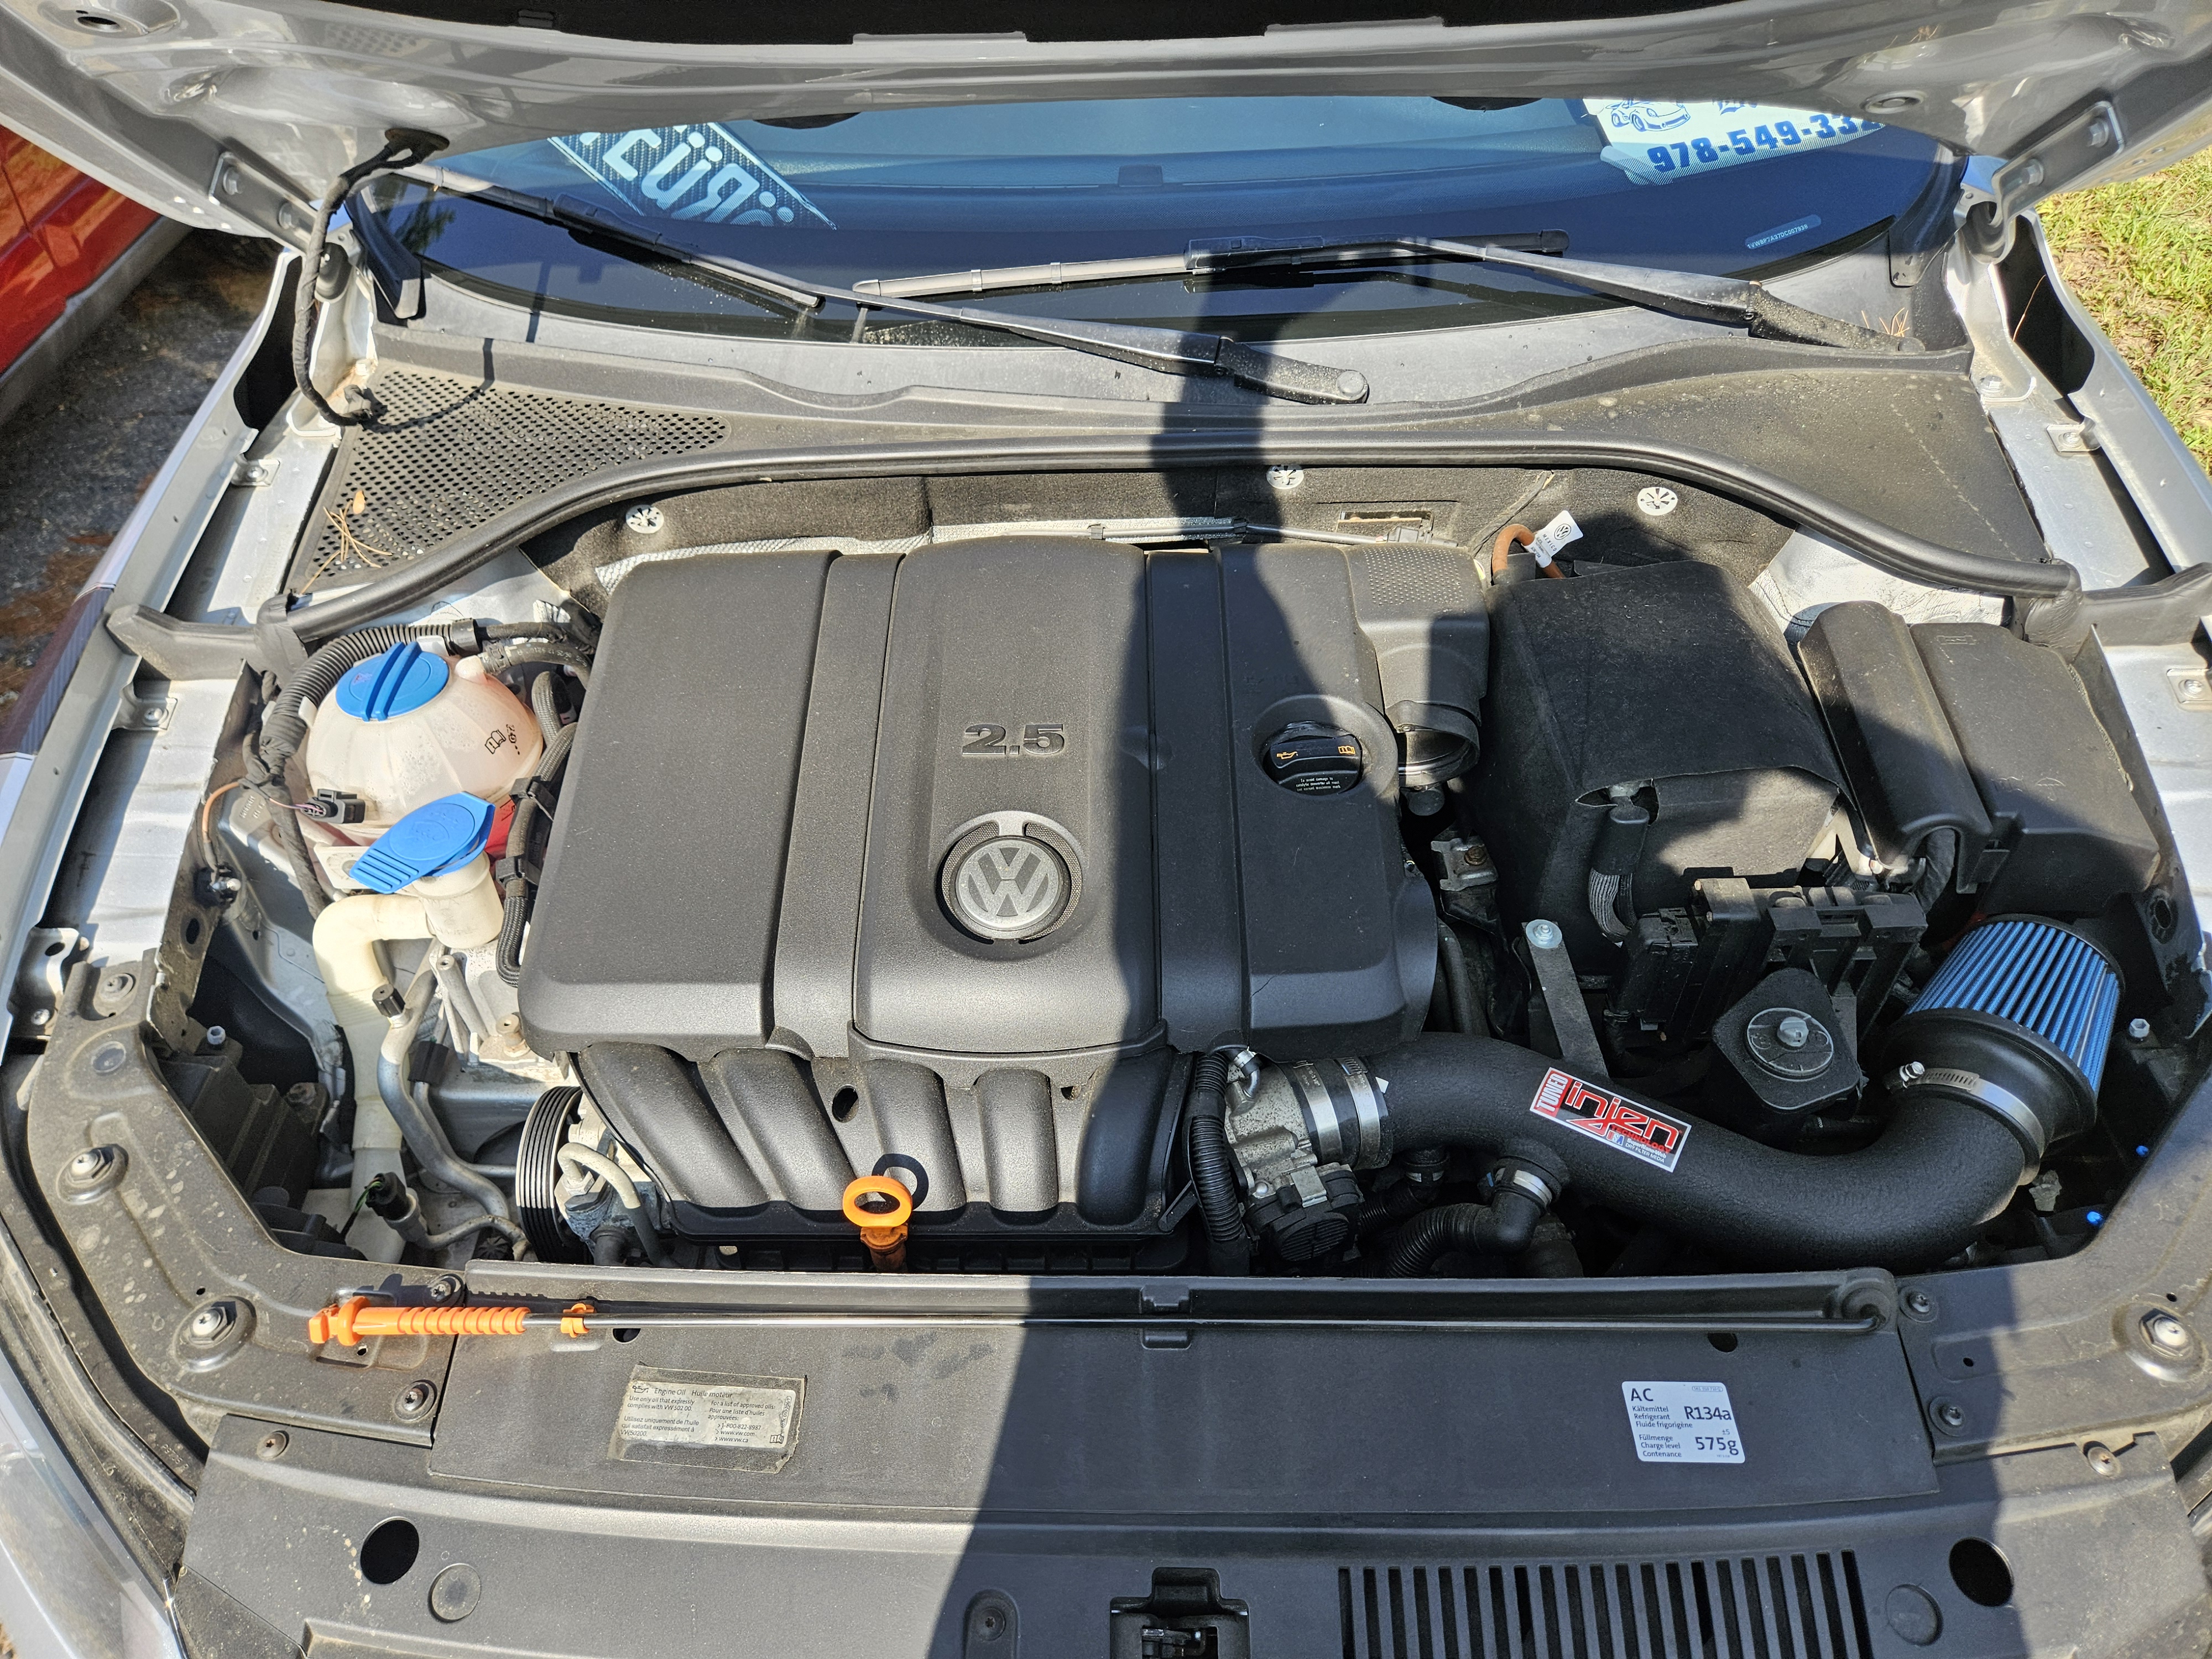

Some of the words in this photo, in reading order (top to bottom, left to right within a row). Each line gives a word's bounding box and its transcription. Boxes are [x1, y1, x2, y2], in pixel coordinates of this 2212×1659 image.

[1542, 534, 1557, 551] MEXICO
[962, 724, 1065, 755] 2.5
[1536, 1072, 1568, 1112] TUNED
[1606, 1130, 1625, 1146] USA
[1611, 1124, 1672, 1153] TECHNOLOGY
[1635, 1146, 1650, 1157] FILTER
[1650, 1153, 1665, 1163] MEDIA
[654, 1388, 676, 1396] Engine
[1684, 1406, 1732, 1420] R134a
[1656, 1421, 1693, 1430] frigorigène
[1639, 1434, 1674, 1443] Füllmenge
[1641, 1442, 1664, 1450] Charge
